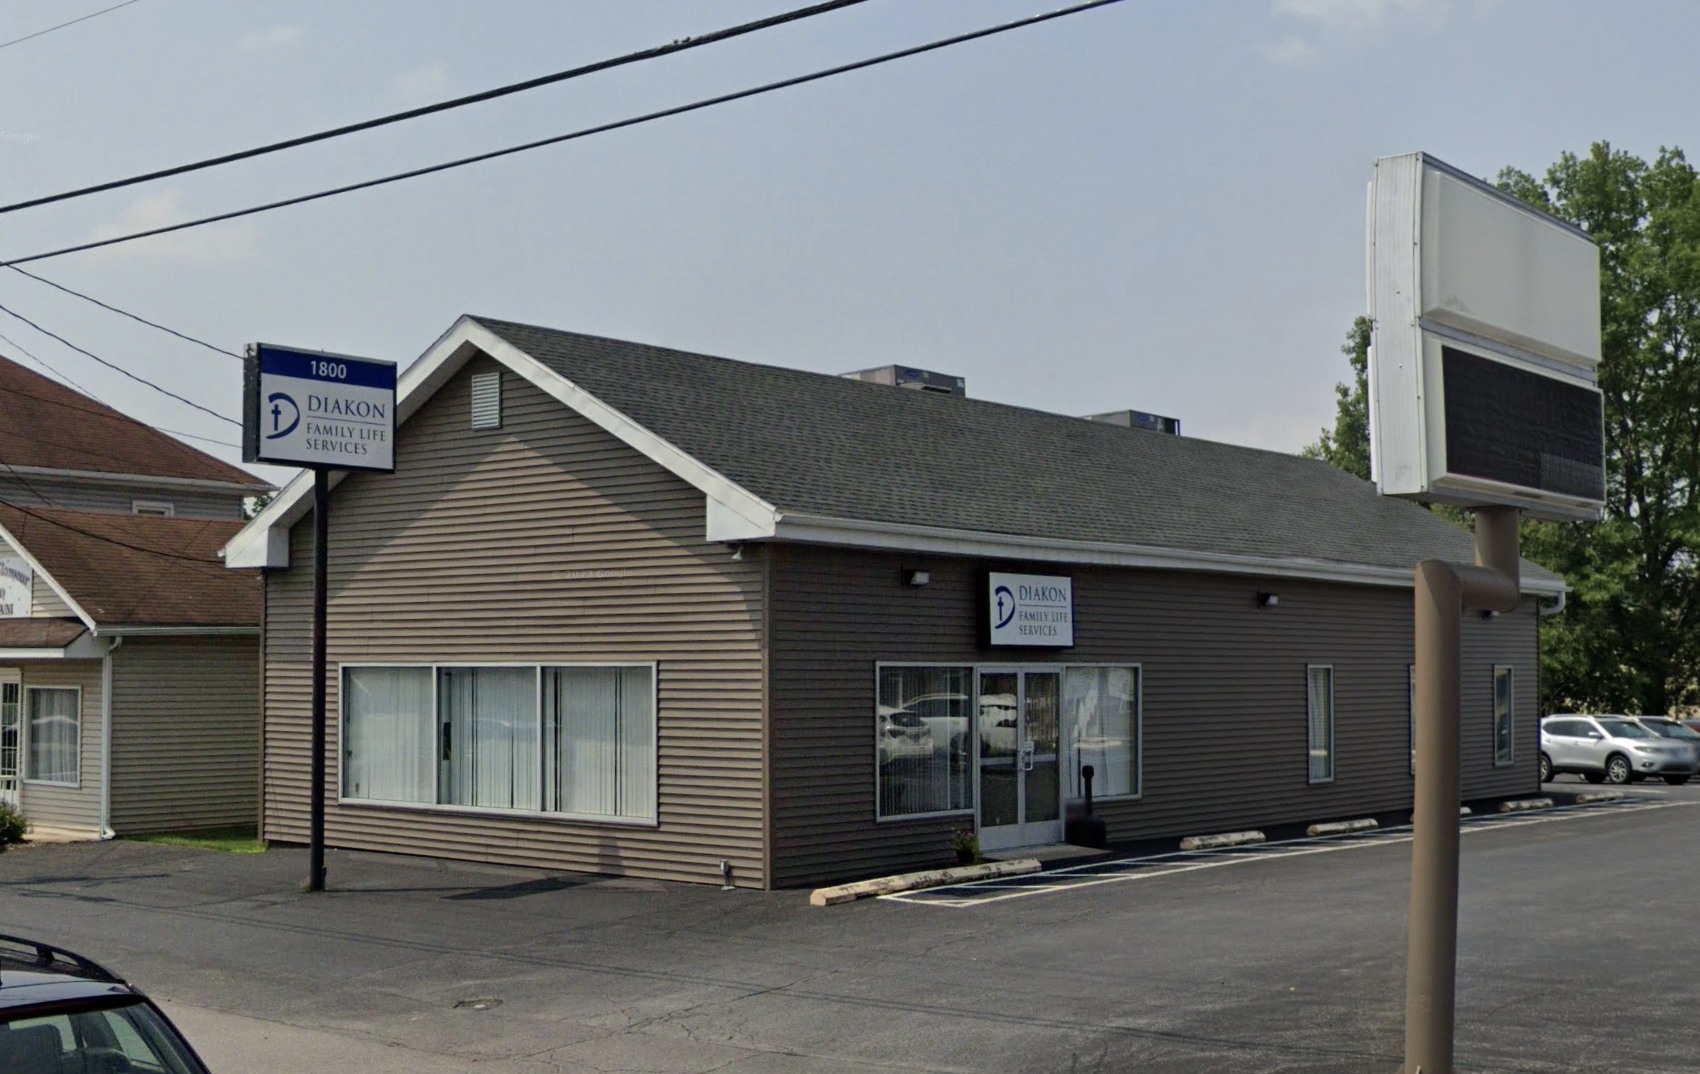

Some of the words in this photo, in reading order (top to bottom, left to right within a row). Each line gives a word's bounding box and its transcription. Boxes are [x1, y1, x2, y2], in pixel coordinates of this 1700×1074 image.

[310, 360, 347, 379] 1800
[308, 394, 386, 419] DIAKON
[306, 422, 356, 440] FAMILY
[360, 428, 387, 442] LIFE
[306, 438, 368, 455] SERVICES
[1019, 585, 1067, 602] DIAKON
[1019, 610, 1049, 622] FAMILY
[1051, 612, 1068, 623] LIFE
[1019, 624, 1058, 636] SERVICES
